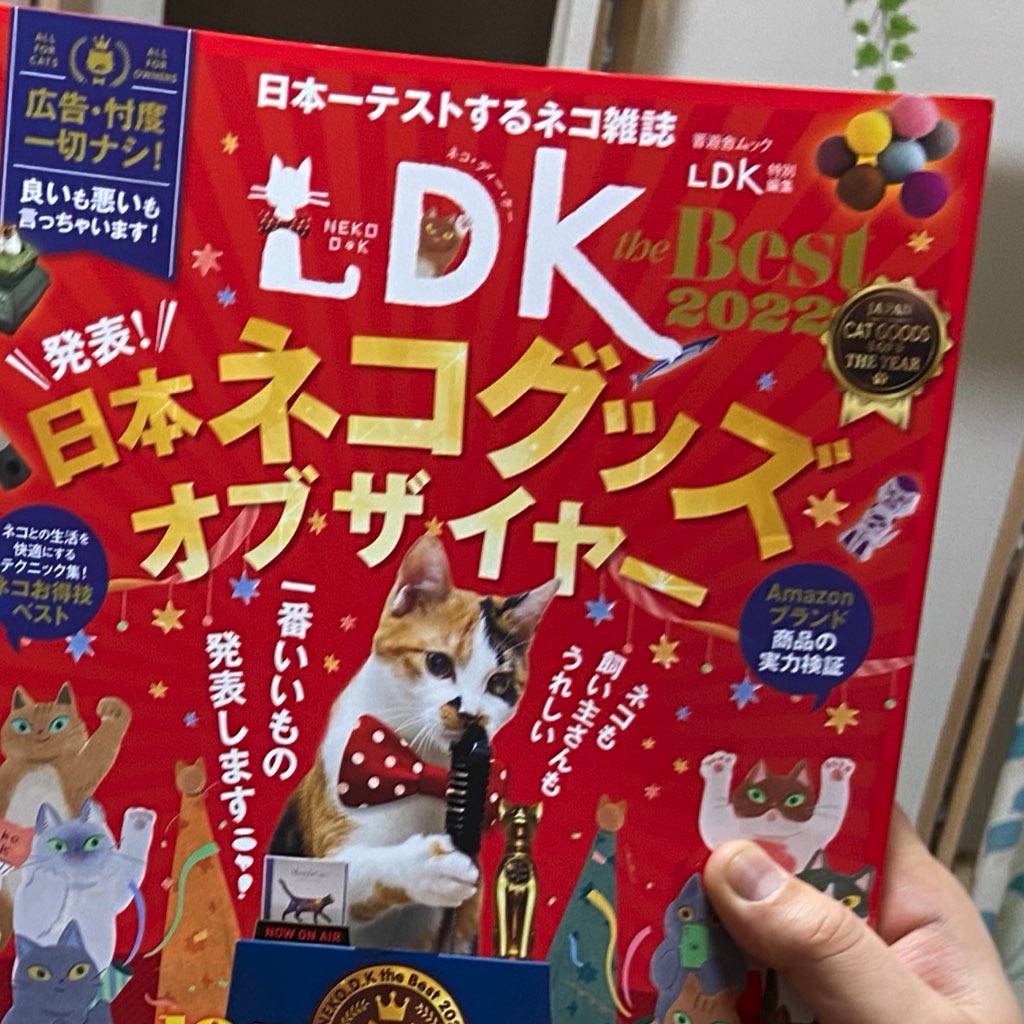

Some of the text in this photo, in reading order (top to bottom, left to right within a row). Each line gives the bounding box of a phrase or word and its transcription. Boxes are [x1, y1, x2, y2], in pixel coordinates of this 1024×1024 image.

[25, 87, 168, 136] 広告・忖度
[257, 72, 678, 147] 日本一テストするネコ雑誌
[687, 156, 765, 196] LDK
[20, 177, 161, 219] 良いも悪いも
[323, 217, 379, 239] NEKO
[613, 206, 873, 291] the Best
[664, 285, 838, 337] 2022
[26, 317, 853, 561] 日本ネコグッズ
[2, 523, 90, 546] ネコとの生活を
[12, 541, 77, 561] 快適にする
[130, 464, 709, 608] オブザイヤー
[12, 601, 70, 627] ベスト
[765, 582, 855, 607] Amazon
[768, 604, 850, 630] ブランド
[770, 628, 838, 652] 商品の
[262, 580, 317, 781] 一番いいもの
[757, 650, 846, 677] 実力検証
[529, 644, 584, 744] うれしい
[540, 649, 628, 798] 飼い主さんも
[596, 682, 650, 751] ネコも
[379, 967, 405, 984] the
[407, 973, 442, 1001] Best
